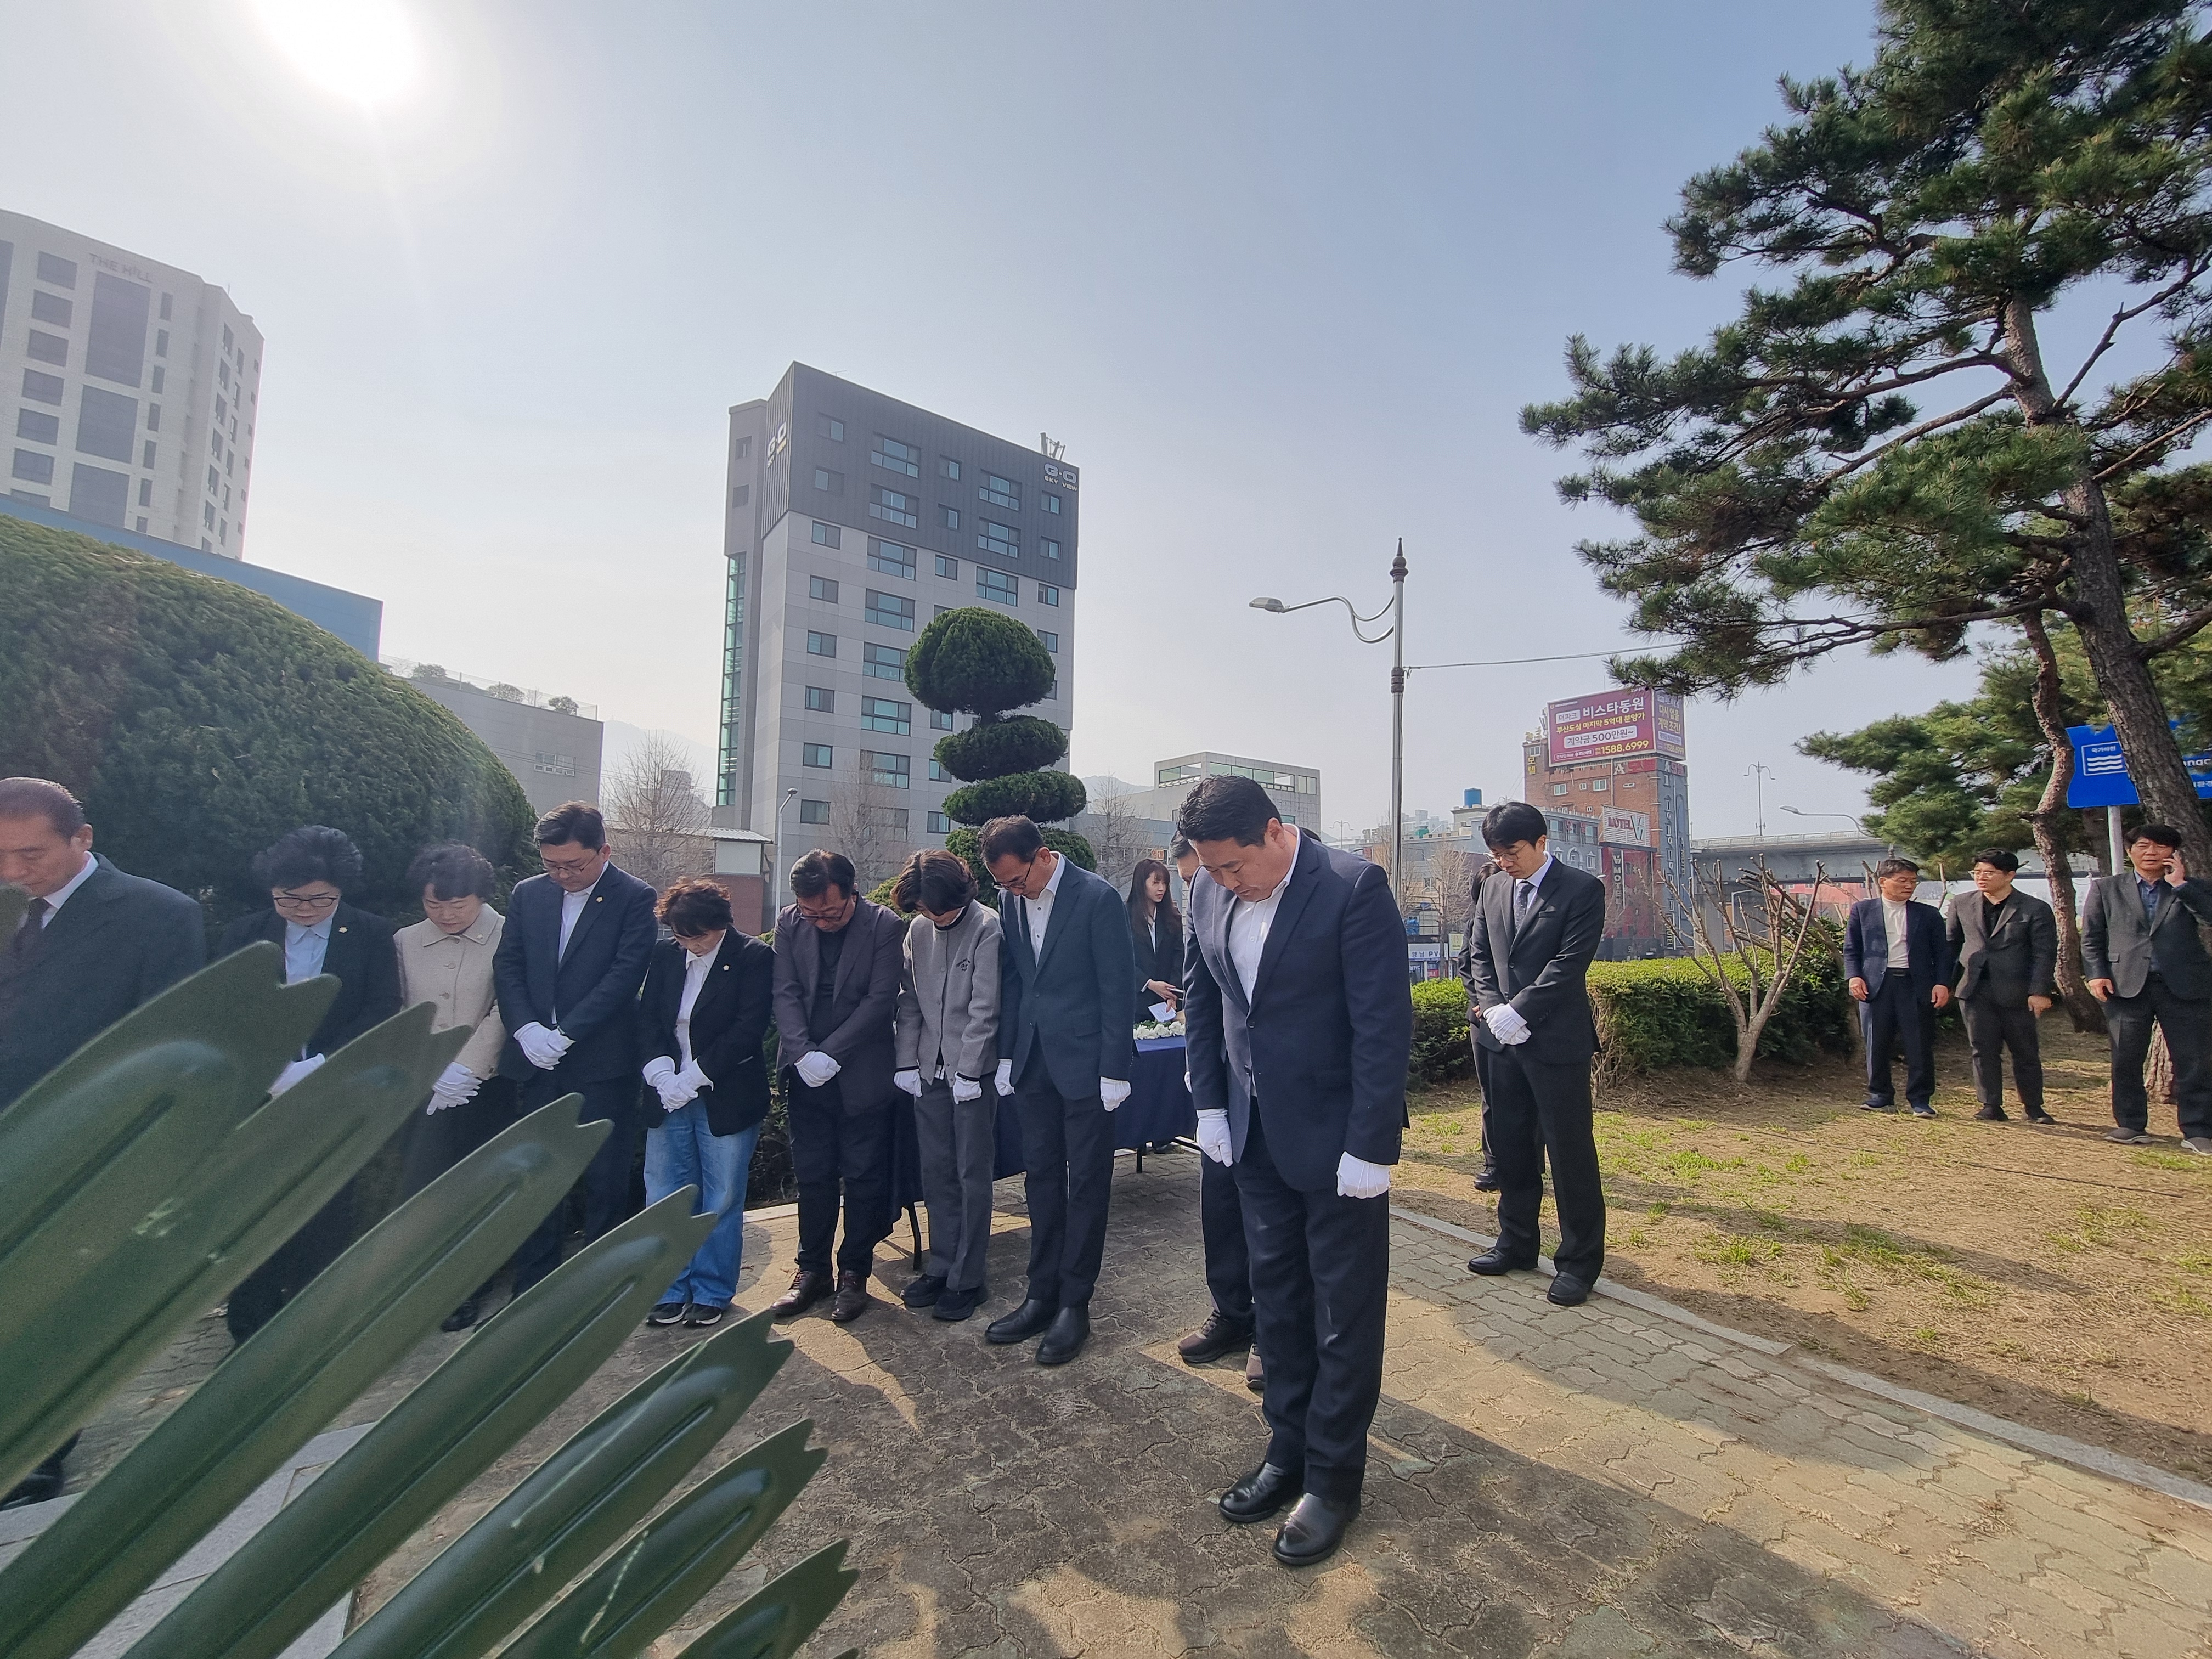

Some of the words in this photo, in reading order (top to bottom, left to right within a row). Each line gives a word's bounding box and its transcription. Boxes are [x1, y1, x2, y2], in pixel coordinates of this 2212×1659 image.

[89, 252, 119, 272] THE
[1044, 475, 1058, 484] SKY
[1062, 482, 1077, 491] VIEW
[1558, 712, 1578, 721] 더파크
[1583, 696, 1645, 719] 비스타동원
[1658, 704, 1669, 719] 다시
[1556, 723, 1582, 734] 부산도심
[1583, 720, 1602, 729] 마지막
[1604, 716, 1623, 726] 5억대
[1624, 712, 1645, 723] 분양가
[1658, 717, 1668, 731] 계약
[1567, 736, 1590, 746] 계약금
[1592, 729, 1634, 742] 500만원~
[1601, 740, 1649, 755] 1588.6999
[1608, 816, 1634, 831] MOTEL
[1613, 866, 1622, 905] MOTEL
